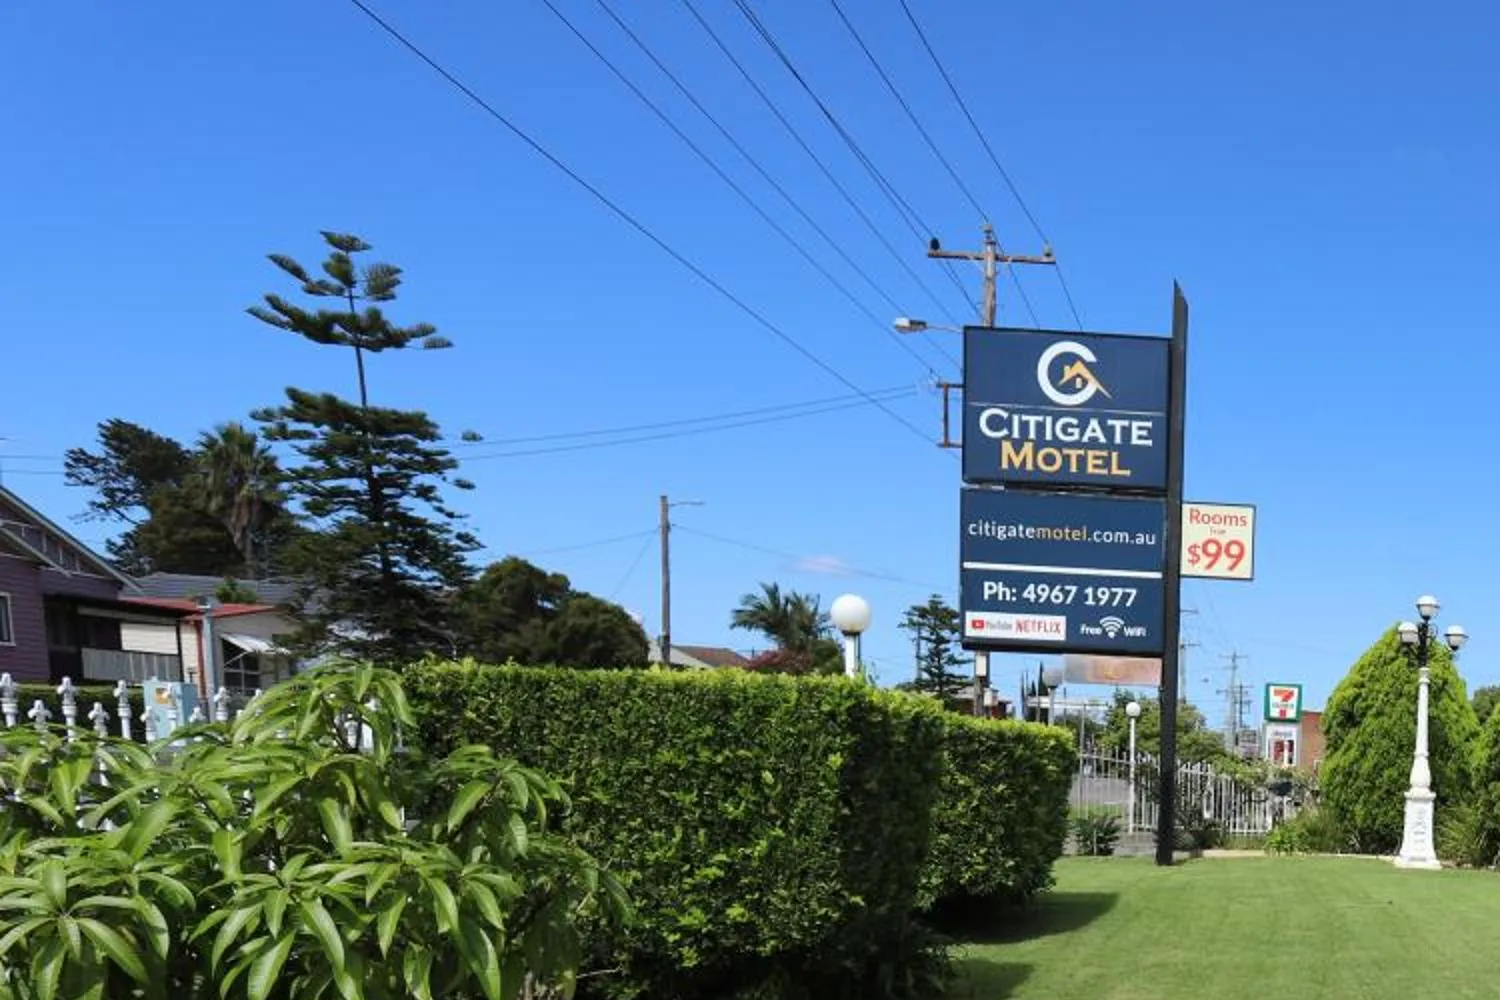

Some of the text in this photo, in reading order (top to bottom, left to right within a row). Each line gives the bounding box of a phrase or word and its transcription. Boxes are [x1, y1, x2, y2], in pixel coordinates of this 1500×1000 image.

[979, 407, 1153, 446] CITIGATE
[1000, 439, 1131, 477] MOTEL
[1189, 507, 1248, 527] Rooms
[968, 519, 1156, 545] citigatemotel.com.au
[1187, 538, 1246, 572] $99
[983, 581, 1137, 608] Ph: 4967 1977
[1016, 620, 1061, 634] NETFLIX
